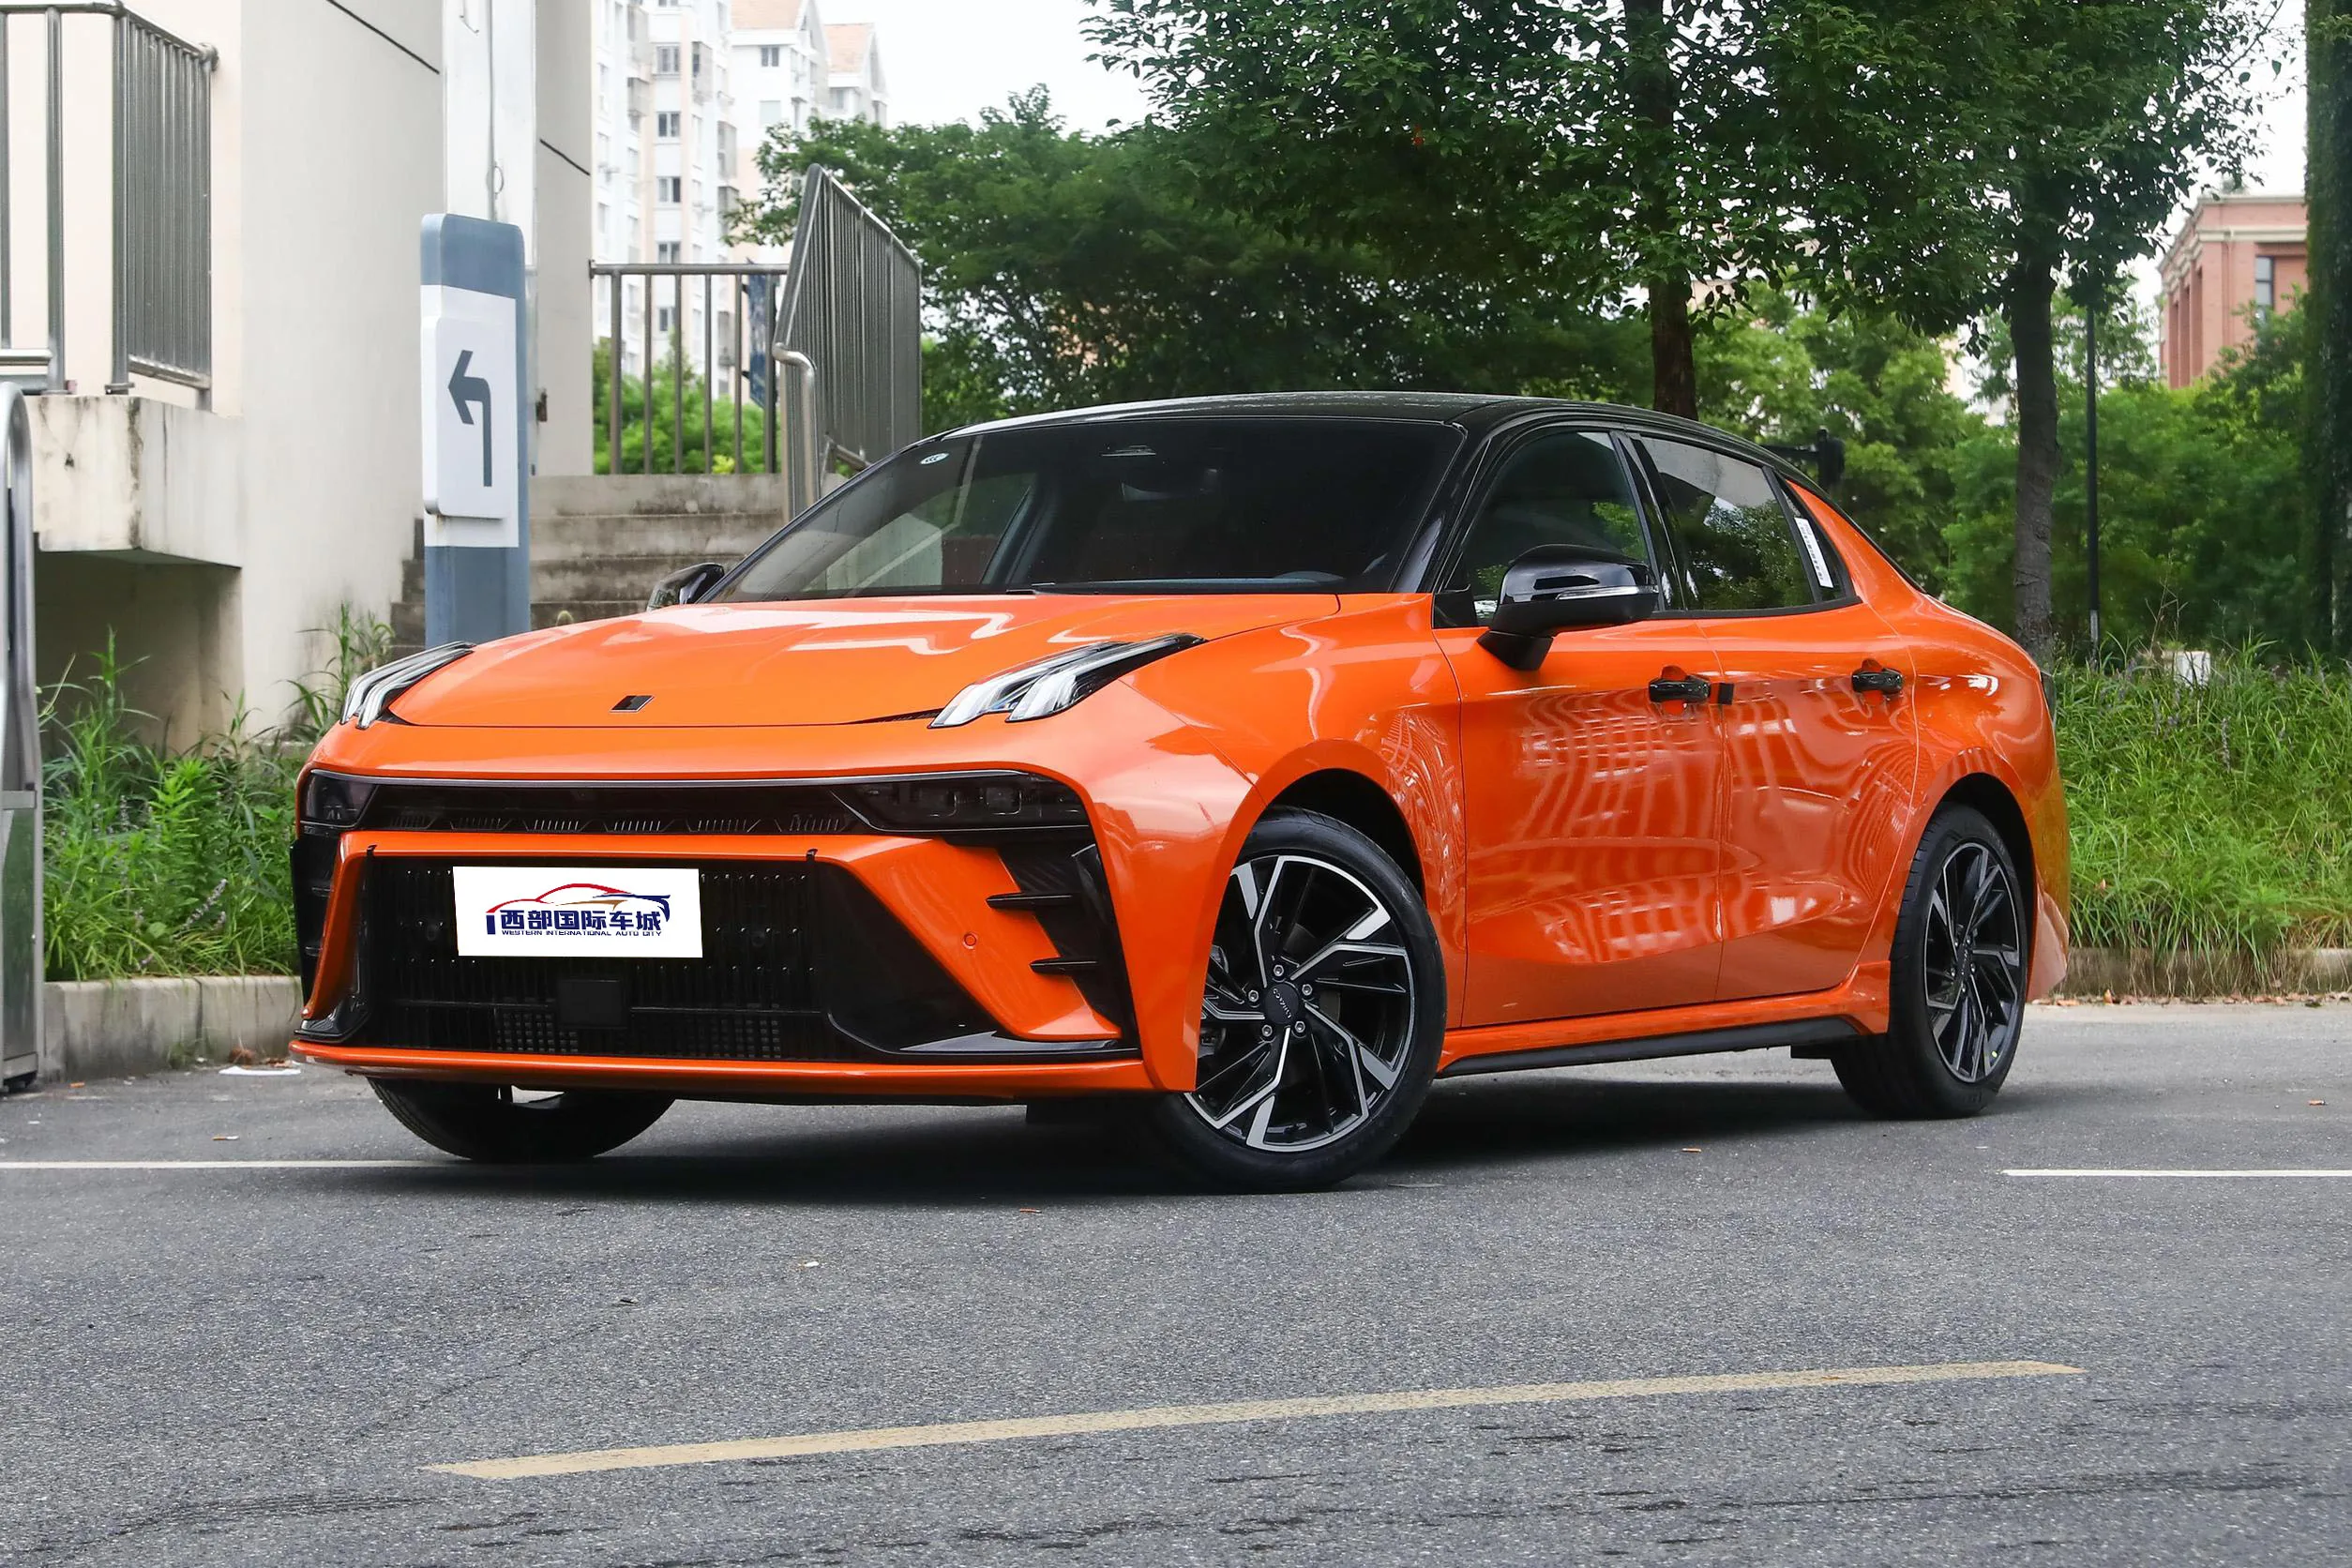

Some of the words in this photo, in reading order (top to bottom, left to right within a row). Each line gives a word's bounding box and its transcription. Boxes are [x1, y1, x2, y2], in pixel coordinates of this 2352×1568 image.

[500, 910, 661, 930] 西部国际车城
